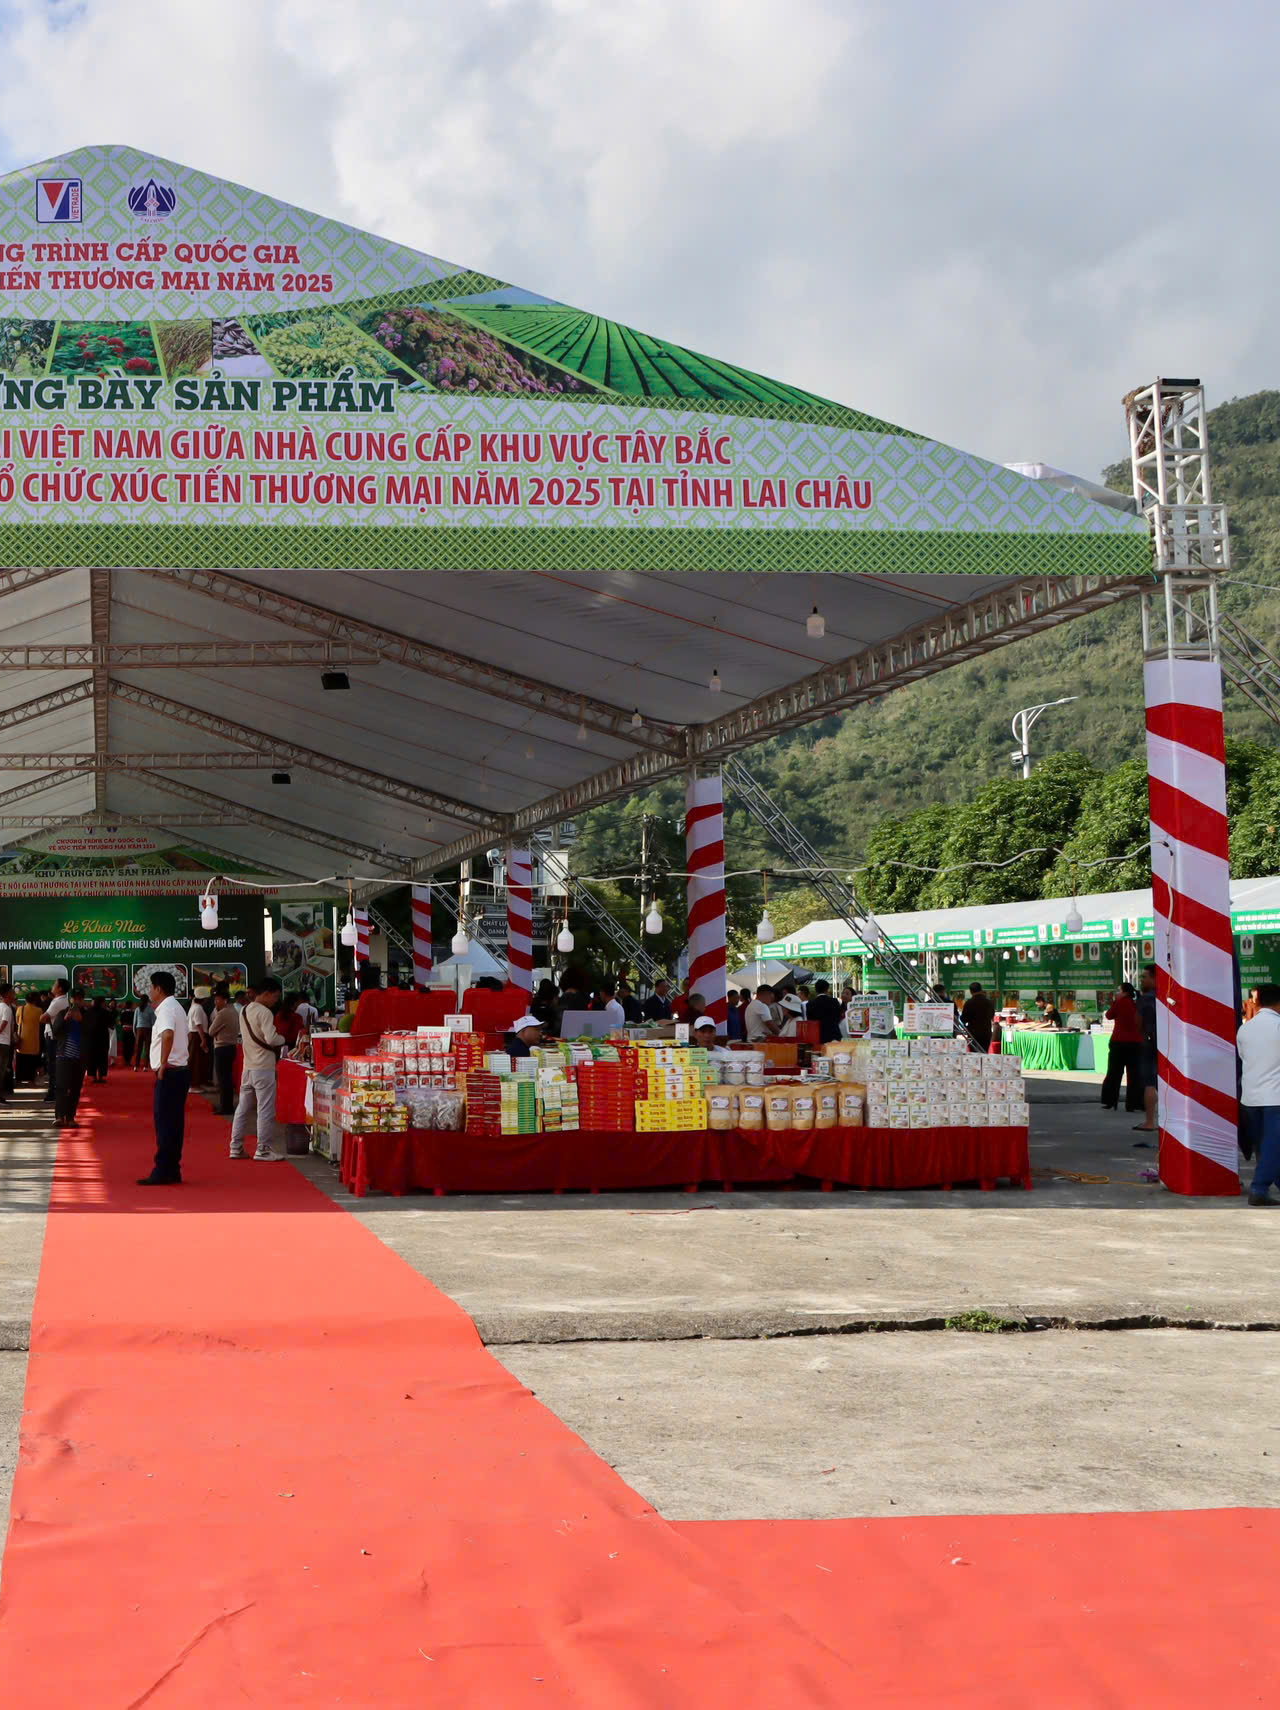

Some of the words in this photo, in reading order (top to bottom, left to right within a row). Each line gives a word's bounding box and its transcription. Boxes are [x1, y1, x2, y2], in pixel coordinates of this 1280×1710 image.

[71, 187, 79, 219] VIETRADE
[31, 237, 110, 262] TRÌNH
[116, 235, 168, 262] CẤP
[175, 238, 248, 264] QUỐC
[254, 245, 301, 264] GIA
[48, 270, 156, 290] THƯƠNG
[161, 272, 211, 296] MẠI
[218, 268, 276, 292] NĂM
[282, 273, 334, 293] 2025
[78, 370, 163, 411] BÀY
[173, 369, 261, 411] SẢN
[272, 366, 395, 413] PHẨM
[19, 424, 84, 467] VIỆT
[95, 430, 162, 460] NAM
[171, 426, 246, 460] GIỮA
[255, 424, 318, 461] NHÀ
[325, 432, 407, 461] CUNG
[415, 423, 472, 462] CẤP
[481, 434, 542, 463] KHU
[550, 432, 608, 470] VỰC
[616, 430, 667, 464] TÂY
[675, 424, 732, 464] BẮC
[24, 467, 104, 502] CHỨC
[112, 467, 169, 503] XÚC
[176, 464, 242, 503] TIẾN
[250, 473, 376, 504] THƯƠNG
[387, 476, 442, 512] MẠI
[452, 471, 520, 505] NĂM
[529, 477, 600, 506] 2025
[608, 478, 654, 514] TẠI
[663, 470, 733, 507] TỈNH
[743, 480, 787, 508] LAI
[795, 475, 873, 509] CHÂU
[60, 919, 81, 934] Lễ
[81, 919, 113, 933] Khai
[114, 920, 147, 935] Mạc
[8, 937, 32, 950] PHẨM
[33, 939, 54, 950] VÙNG
[55, 938, 76, 949] ĐỒNG
[77, 938, 93, 949] BÀO
[94, 938, 110, 949] DÂN
[112, 938, 126, 951] TỘC
[128, 936, 148, 949] THIỂU
[150, 937, 160, 948] SỐ
[161, 938, 172, 948] VÀ
[173, 937, 193, 948] MIỀN
[194, 937, 208, 948] NÚI
[209, 937, 226, 948] PHÍA
